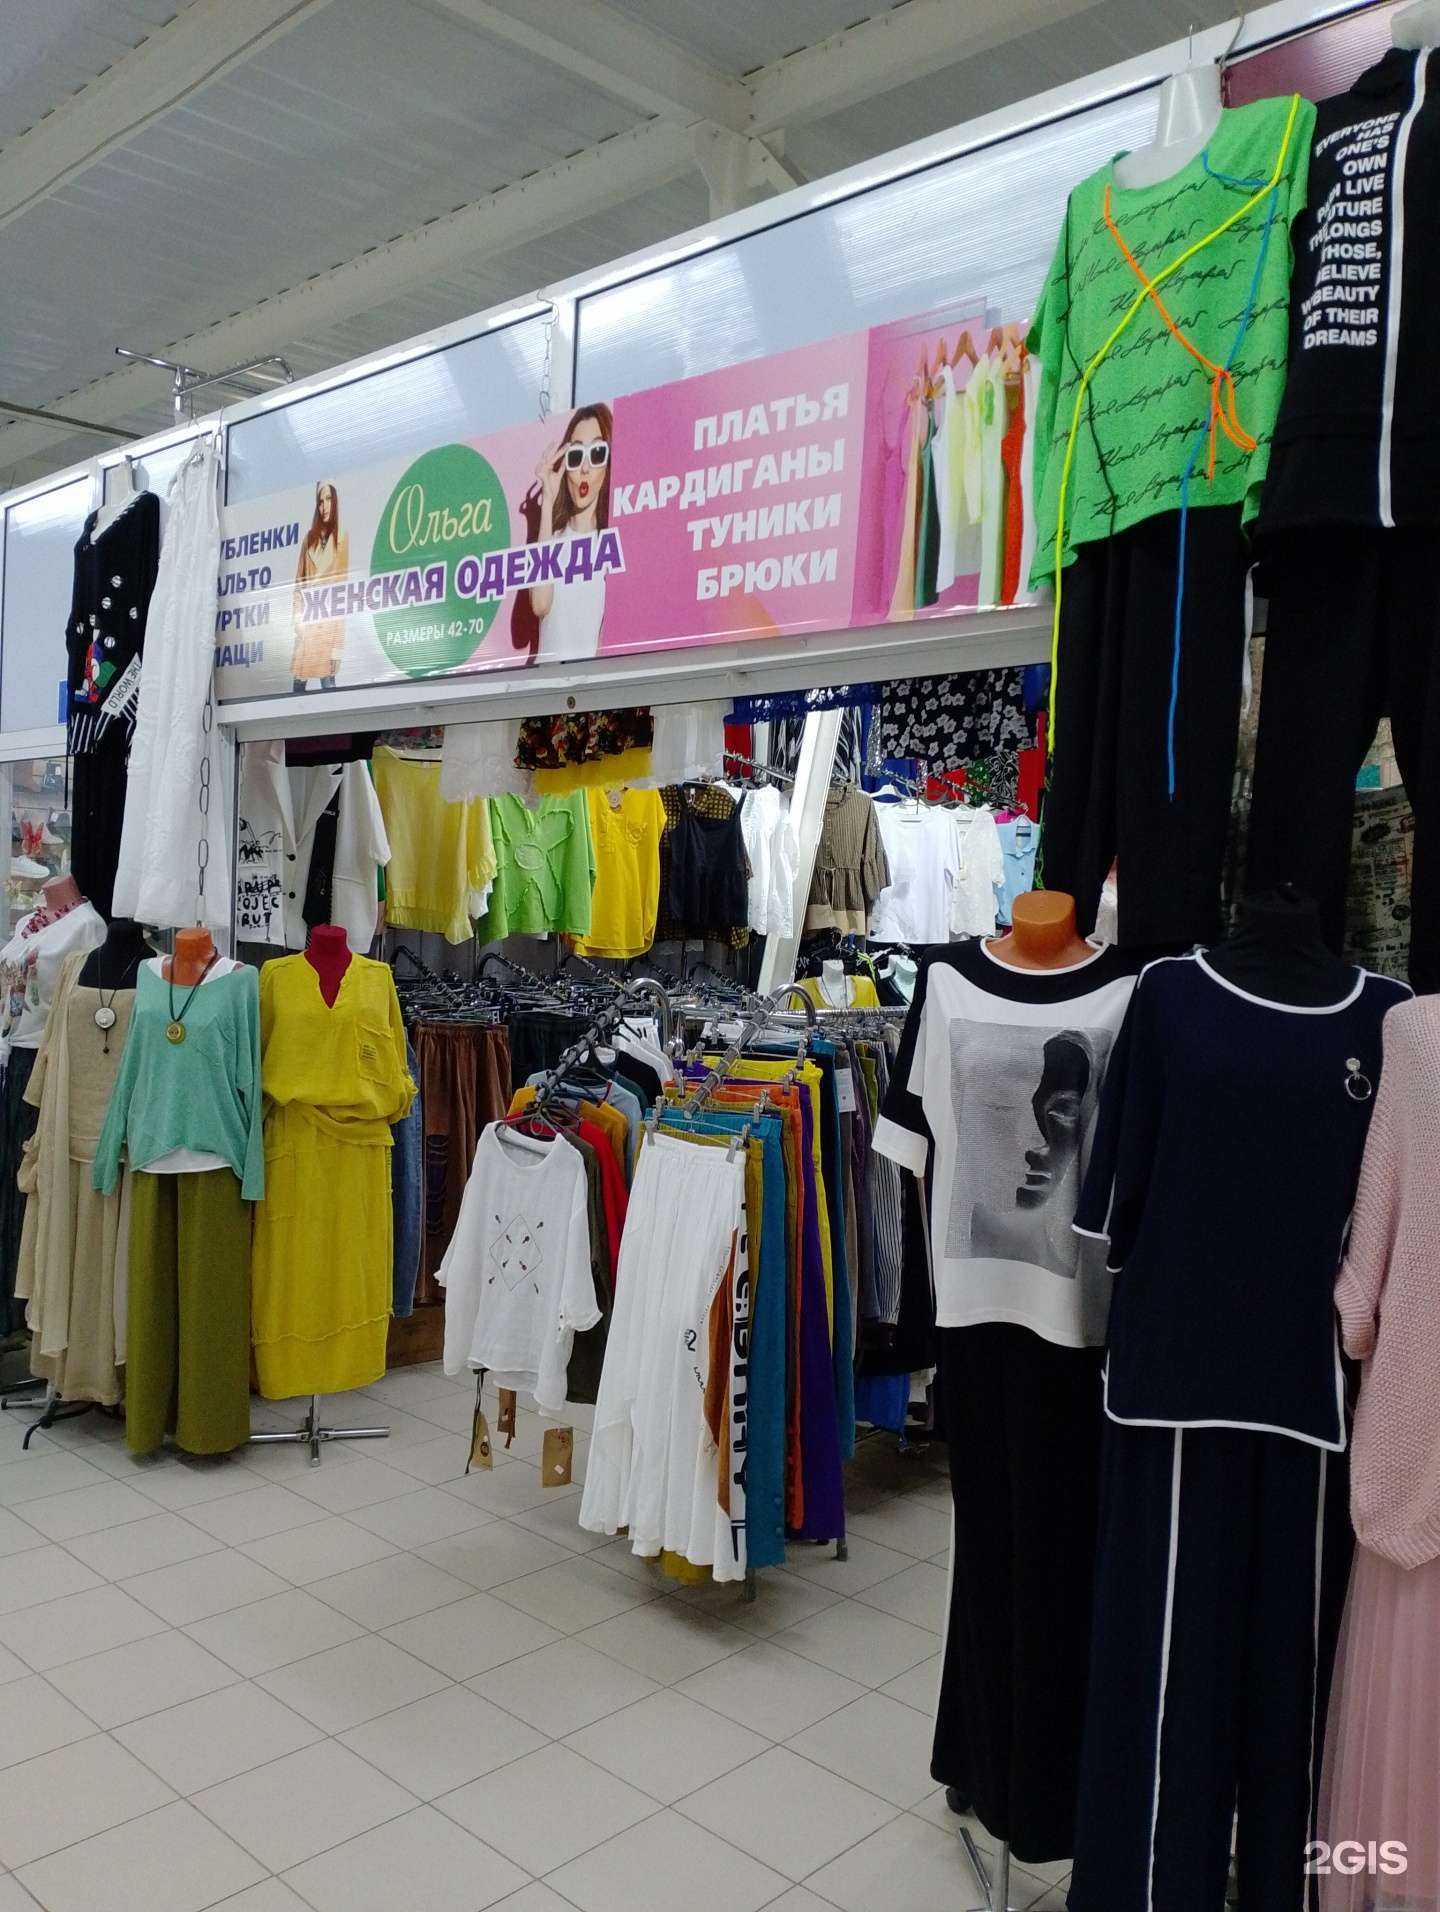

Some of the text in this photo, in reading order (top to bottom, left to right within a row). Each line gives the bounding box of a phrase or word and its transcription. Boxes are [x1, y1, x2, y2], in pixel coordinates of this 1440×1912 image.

[1315, 111, 1401, 158] EVERYONE
[1356, 122, 1395, 141] HAS
[1335, 134, 1390, 161] ONE'S
[1342, 152, 1388, 176] OWN
[1345, 173, 1385, 195] LIVE
[1326, 196, 1384, 222] UTURE
[1303, 310, 1322, 331] OF
[1325, 307, 1379, 325] THEIR
[1303, 328, 1378, 349] DREAMS
[693, 382, 849, 451] ПЛАТЬЯ
[612, 438, 846, 517] КАРДИГАНЫ
[389, 483, 493, 554] Ольга
[687, 494, 842, 551] ТУНИКИ
[220, 522, 300, 561] БЛЕНКИ
[301, 529, 624, 624] ЖЕНСКАЯ ОДЕЖДА
[696, 549, 838, 601] БРЮКИ
[386, 617, 485, 646] РАЗМЕРЫ 42-70
[108, 678, 134, 709] WORLD
